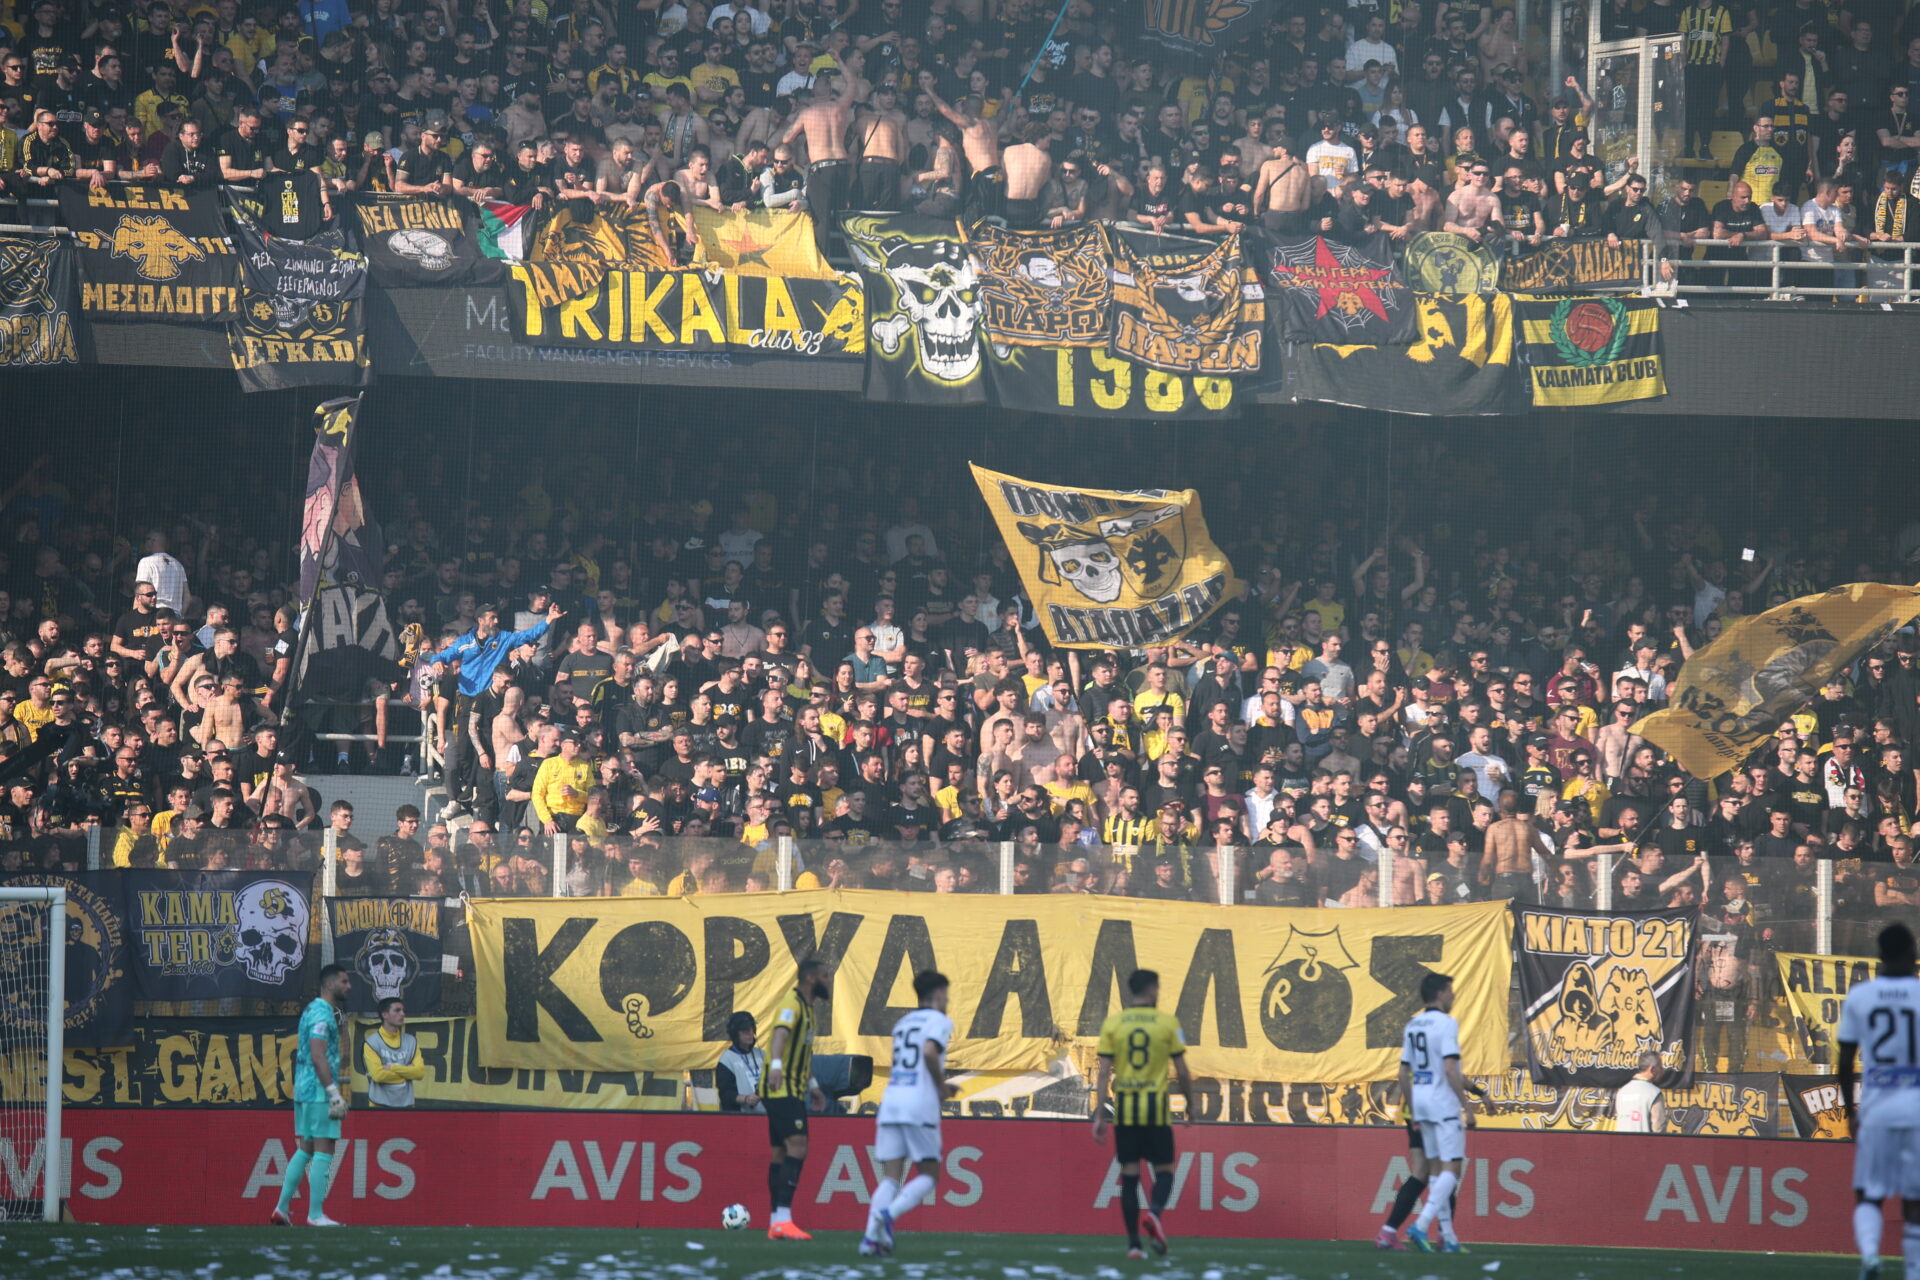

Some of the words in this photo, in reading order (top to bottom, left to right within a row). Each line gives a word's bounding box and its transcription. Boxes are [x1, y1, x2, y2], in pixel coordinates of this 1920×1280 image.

[466, 344, 532, 361] FACILITY
[539, 348, 650, 366] MANAGEMENT
[656, 352, 732, 370] SERVICES
[1537, 366, 1613, 388] KALAMATA
[1616, 360, 1658, 382] CLUB
[138, 891, 240, 926] KAMA
[1525, 913, 1635, 957] KIATO
[1642, 918, 1686, 957] 21
[1128, 1027, 1151, 1070] 8
[1408, 1031, 1429, 1069] 19
[1868, 1007, 1918, 1066] 21
[1743, 1089, 1767, 1119] 21
[0, 1137, 124, 1200] VIS
[530, 1140, 703, 1202] AVIS
[1645, 1163, 1809, 1227] AVIS
